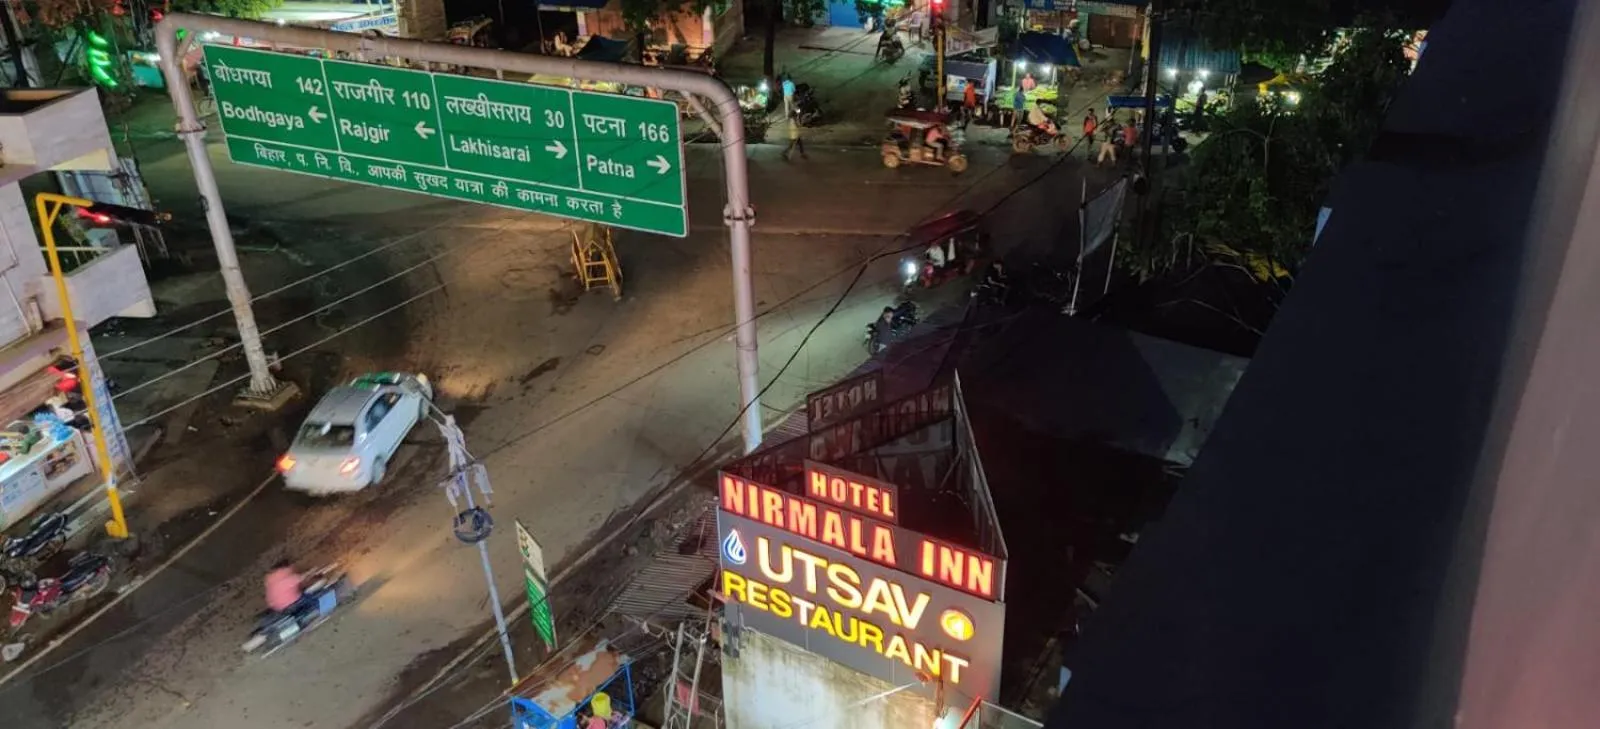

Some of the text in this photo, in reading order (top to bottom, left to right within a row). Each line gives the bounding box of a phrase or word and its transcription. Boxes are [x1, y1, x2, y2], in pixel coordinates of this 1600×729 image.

[212, 58, 324, 97] बोधगया 142
[332, 79, 431, 110] राजगीर 110
[221, 101, 304, 131] Bodhgaya
[339, 119, 390, 144] Rajgir
[545, 109, 565, 129] 30
[582, 113, 670, 143] पटना 166
[449, 135, 530, 163] Lakhisarai
[586, 154, 635, 178] Patna
[368, 165, 407, 182] आपकी
[413, 171, 448, 191] सुखद
[455, 177, 483, 195] यात्रा
[491, 178, 509, 199] की
[516, 188, 558, 207] कामना
[566, 196, 604, 215] करता
[811, 471, 895, 517] HOTEL
[723, 476, 993, 596] NIRMALA INN
[757, 536, 930, 629] UTSAV
[722, 570, 969, 684] RESTAURANT
